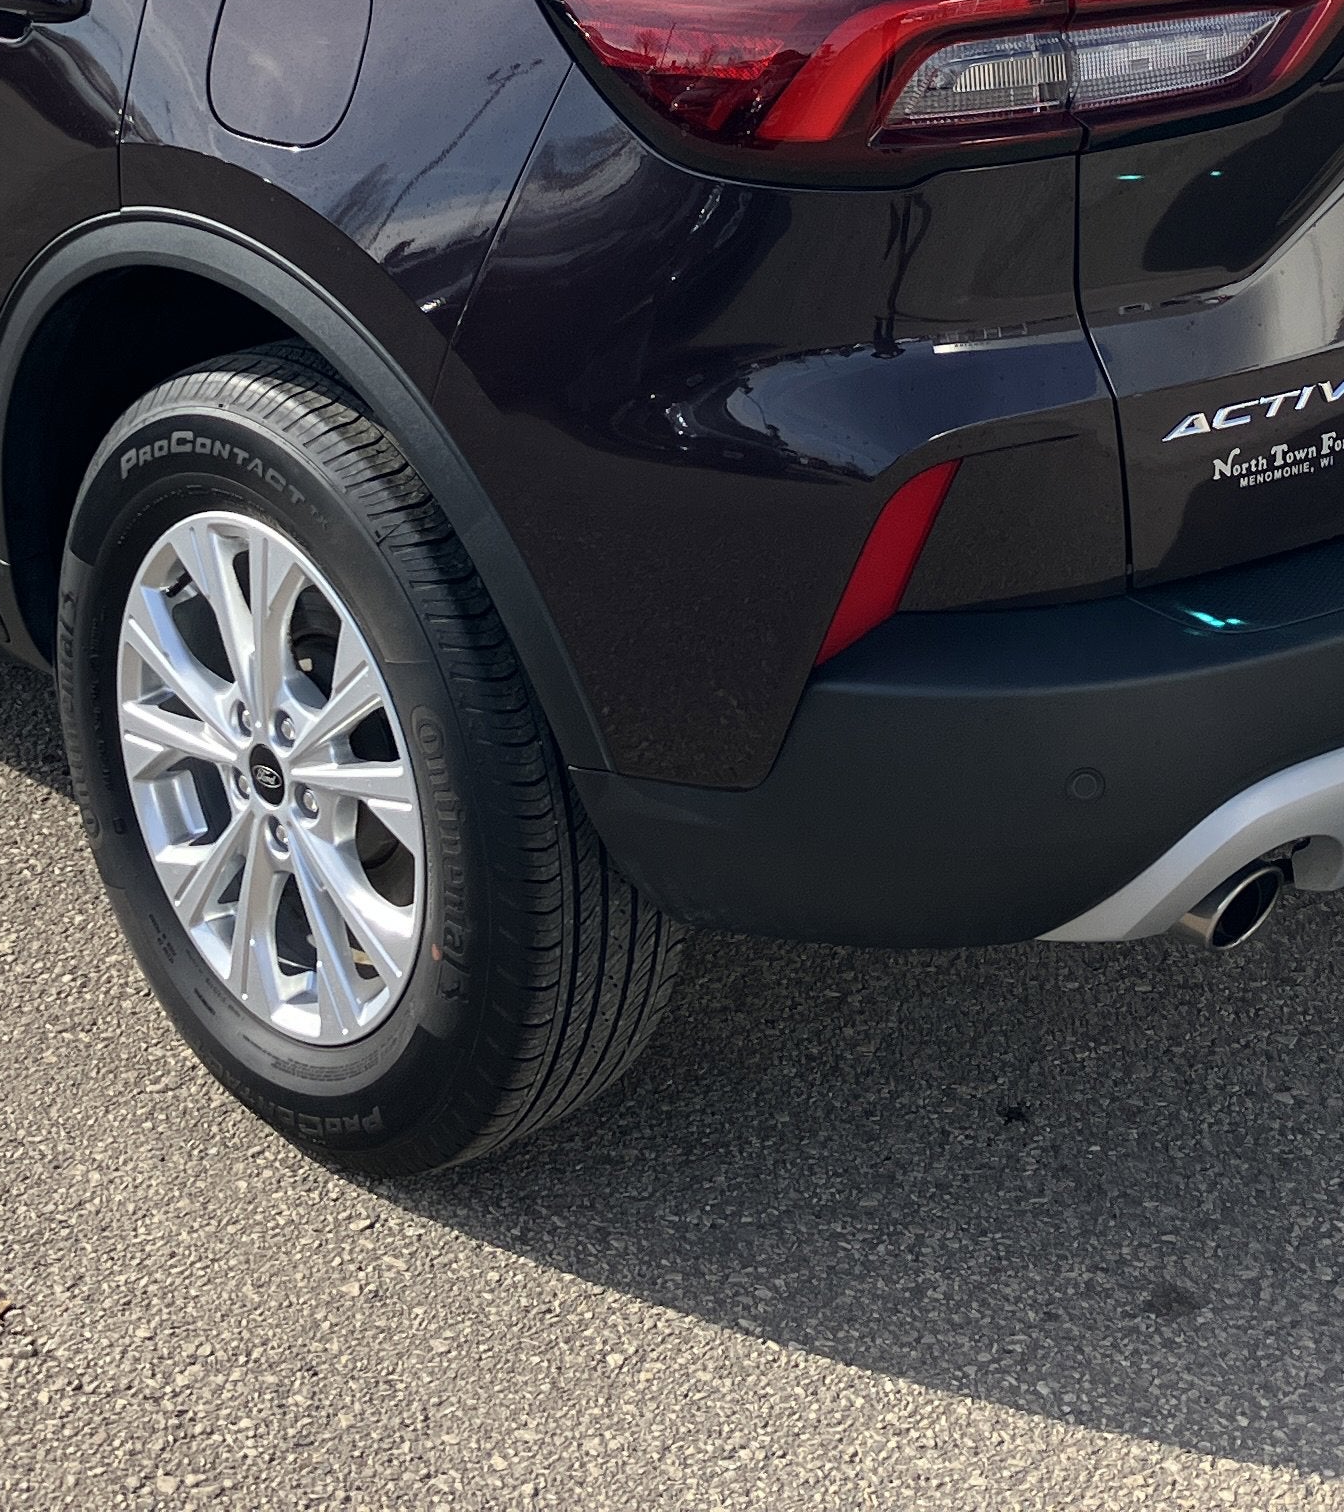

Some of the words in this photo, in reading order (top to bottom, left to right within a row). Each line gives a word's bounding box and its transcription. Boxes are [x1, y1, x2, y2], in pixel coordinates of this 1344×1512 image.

[1212, 447, 1267, 480] North
[1271, 443, 1317, 467] Town
[1239, 461, 1315, 488] MENOMONIE,
[1320, 455, 1334, 468] WI
